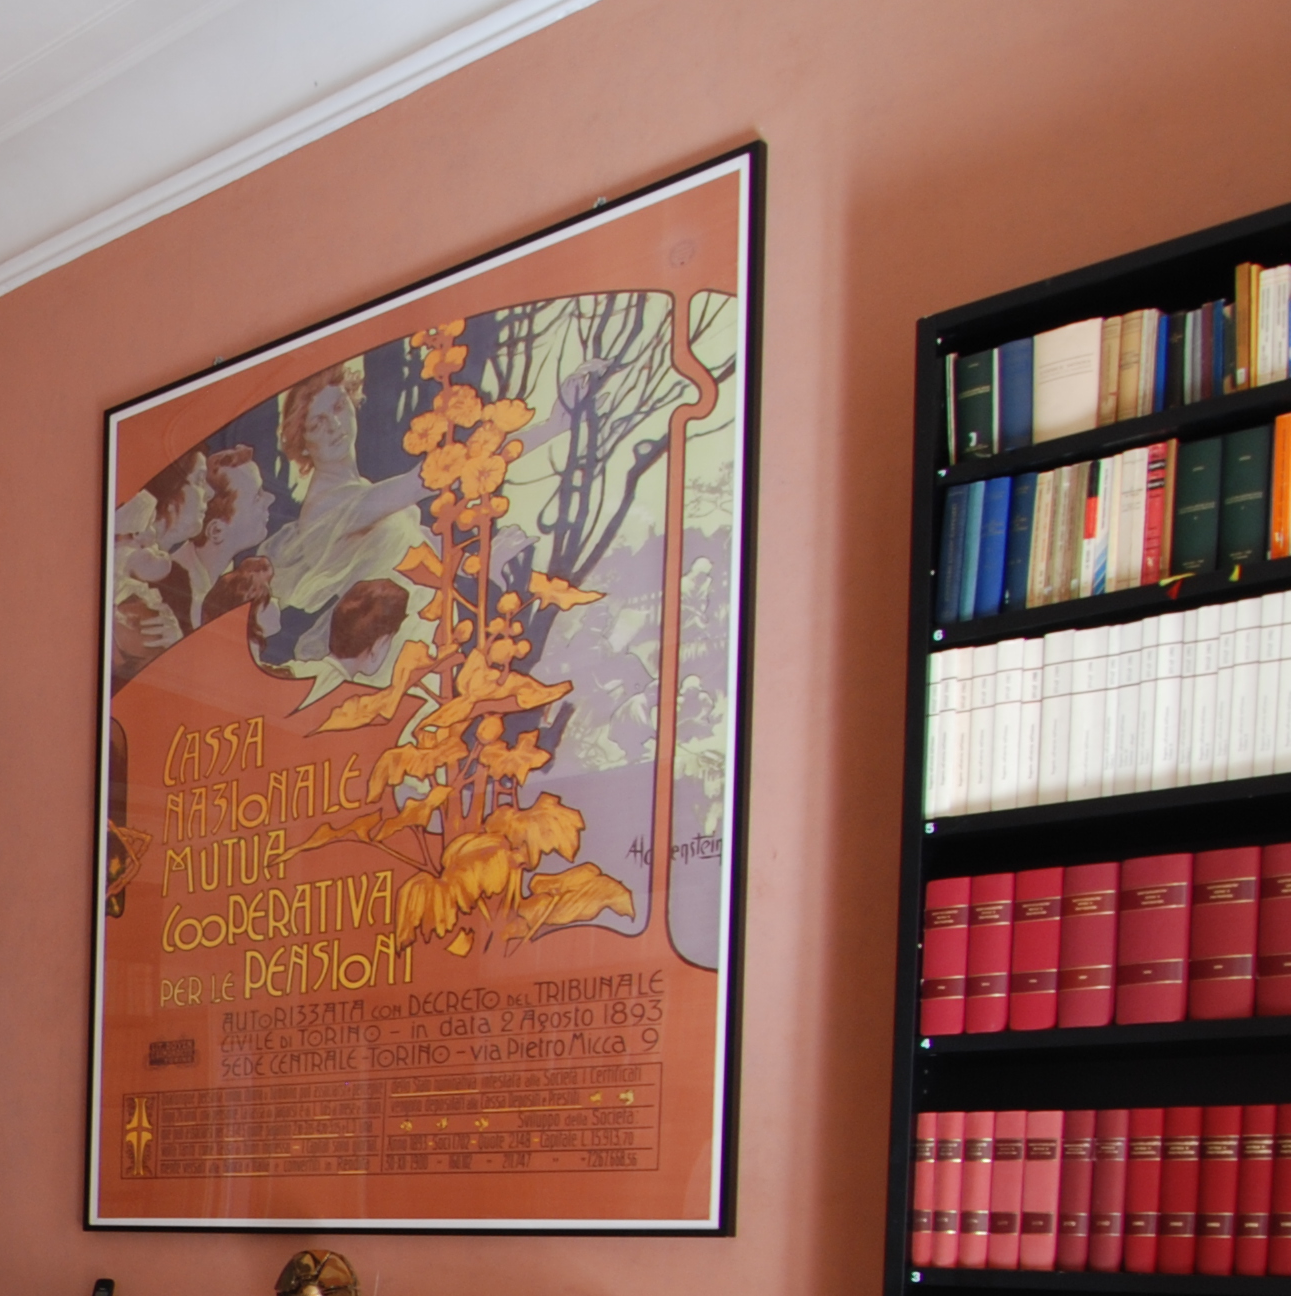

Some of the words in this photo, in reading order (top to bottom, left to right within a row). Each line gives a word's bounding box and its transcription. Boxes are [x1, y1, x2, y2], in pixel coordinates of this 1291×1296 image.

[932, 629, 944, 642] 6
[163, 715, 265, 787] CASSA
[162, 753, 362, 845] NAZIONALE
[924, 822, 936, 835] 5
[161, 829, 287, 897] MUTUA
[162, 869, 395, 953] COOPERATIVA
[160, 976, 203, 1008] PER
[211, 972, 236, 1005] LE
[244, 932, 414, 1000] PENSIONI
[221, 1031, 274, 1054] CIVILE
[280, 1035, 293, 1049] DI
[297, 1025, 382, 1049] TORINO
[412, 1021, 429, 1039] in
[439, 1016, 492, 1038] data
[500, 1010, 515, 1033] 2
[520, 1007, 594, 1034] Agosto
[603, 999, 663, 1026] 1893
[222, 999, 365, 1034] AUTORIZZATA
[371, 1004, 402, 1020] CON
[408, 987, 501, 1018] DECRETO
[507, 994, 533, 1007] DEL
[534, 969, 665, 1005] TRIBUNALE
[222, 1055, 267, 1079] SEDE
[269, 1049, 358, 1075] CENTRALE
[470, 1042, 502, 1062] via
[507, 1037, 566, 1059] Pietro
[569, 1032, 628, 1056] Micca
[641, 1027, 660, 1053] 9
[919, 1038, 931, 1050] 4
[590, 1065, 642, 1084] Certificati
[517, 1112, 560, 1131] Sviluppo
[540, 1131, 578, 1150] Capitale
[910, 1271, 922, 1283] 3
